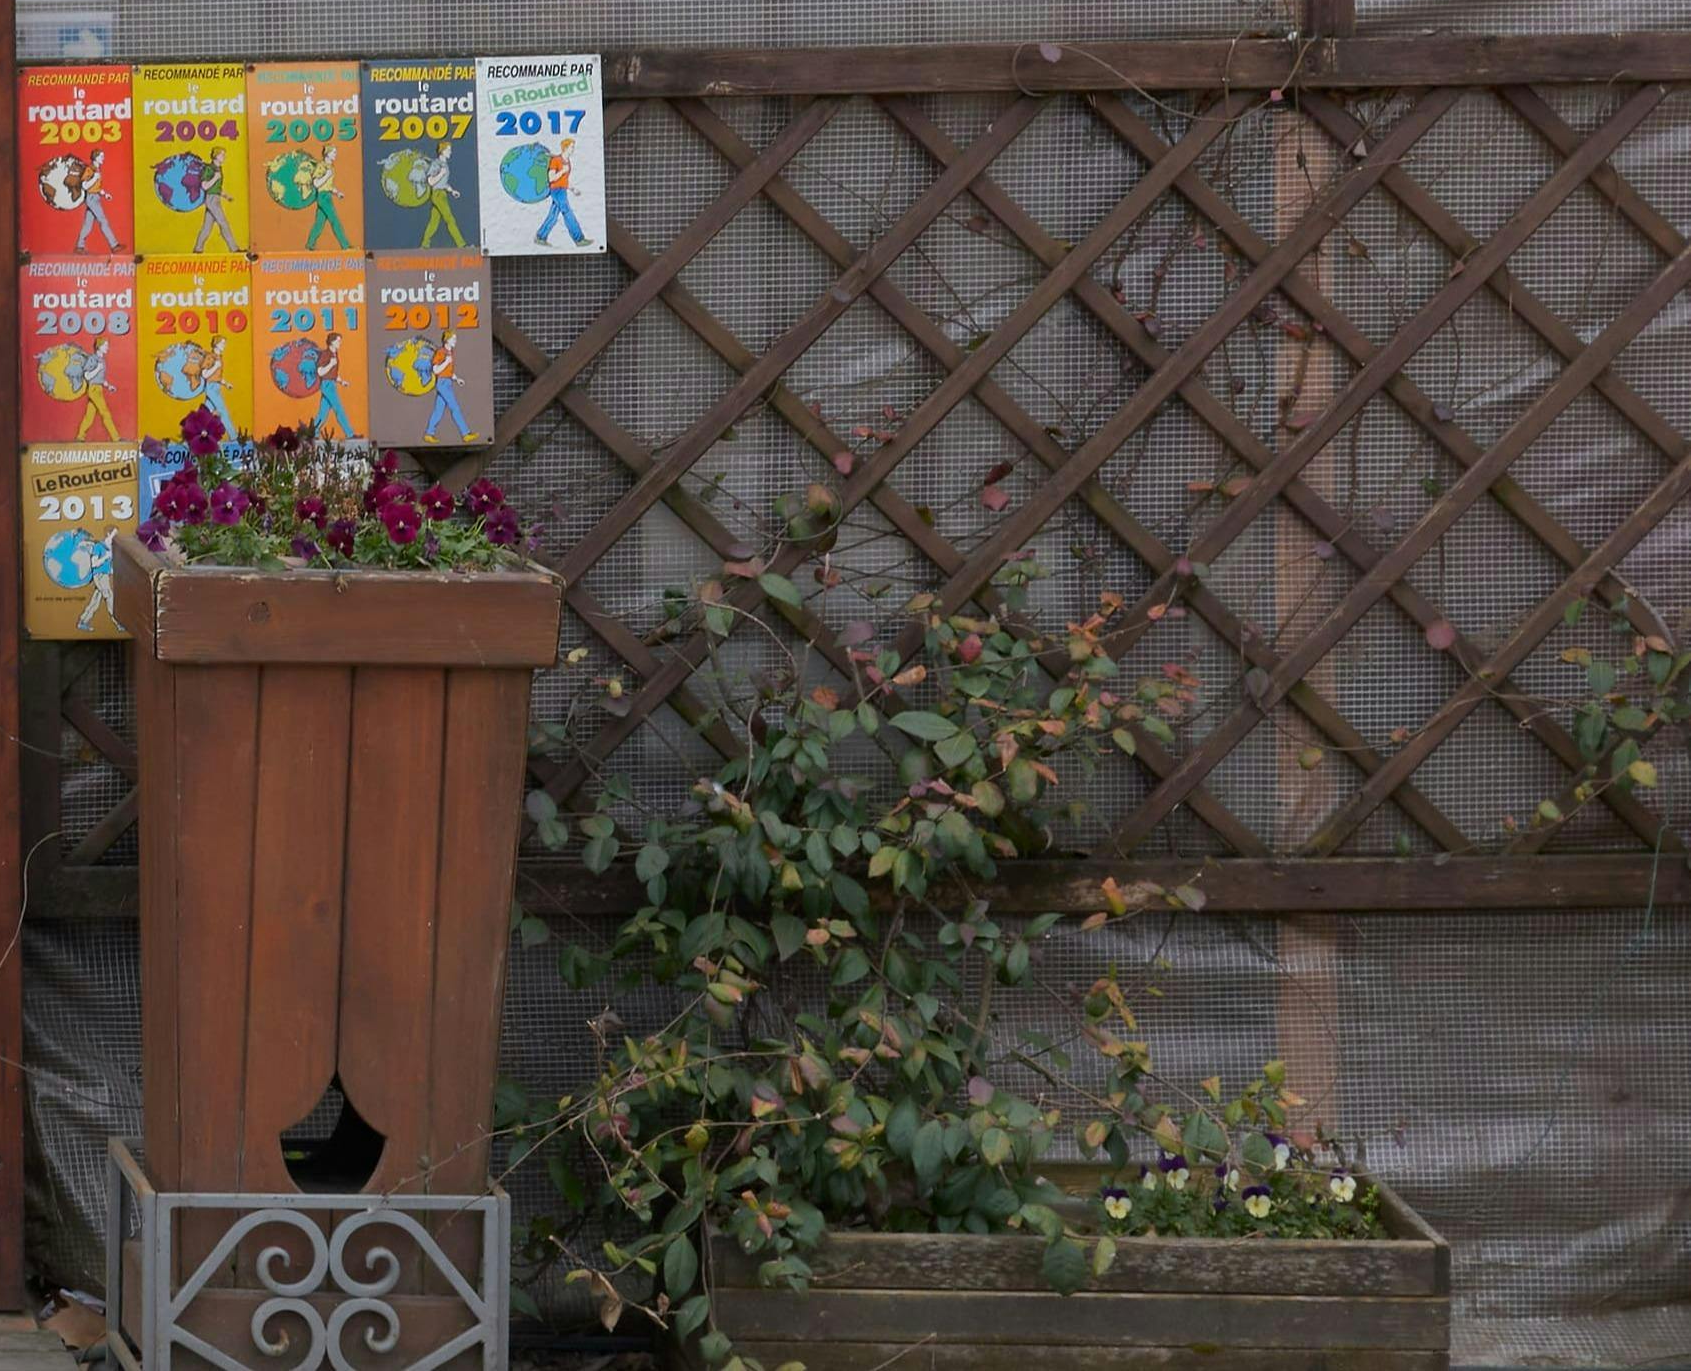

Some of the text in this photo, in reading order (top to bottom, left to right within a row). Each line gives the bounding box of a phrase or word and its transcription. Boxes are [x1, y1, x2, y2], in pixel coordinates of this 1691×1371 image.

[107, 73, 130, 84] PAR
[144, 65, 244, 80] RECOMMANDÉ PAR
[371, 63, 452, 81] RECOMMANDÉ
[488, 61, 593, 78] RECOMMANDÉ PAR
[73, 86, 86, 99] le
[187, 82, 200, 93] le
[303, 82, 315, 93] le
[418, 81, 429, 92] le
[28, 97, 131, 122] routard
[143, 93, 245, 115] routard
[260, 95, 359, 116] routard
[375, 92, 474, 115] routard
[40, 120, 122, 145] 2003
[155, 120, 240, 142] 2004
[266, 116, 357, 142] 2005
[379, 114, 473, 141] 2007
[495, 109, 586, 135] 2017
[113, 262, 135, 276] PAR
[147, 259, 251, 275] RECOMMANDÉ PAR
[424, 270, 436, 282] le
[76, 276, 88, 287] le
[193, 274, 205, 285] le
[308, 272, 320, 284] le
[33, 289, 132, 309] routard
[150, 286, 249, 308] routard
[265, 284, 364, 305] routard
[381, 281, 479, 303] routard
[35, 311, 130, 336] 2008
[155, 309, 248, 335] 2010
[270, 307, 358, 332] 2011
[385, 304, 479, 329] 2012
[114, 450, 137, 462] PAR
[38, 495, 134, 521] 2013
